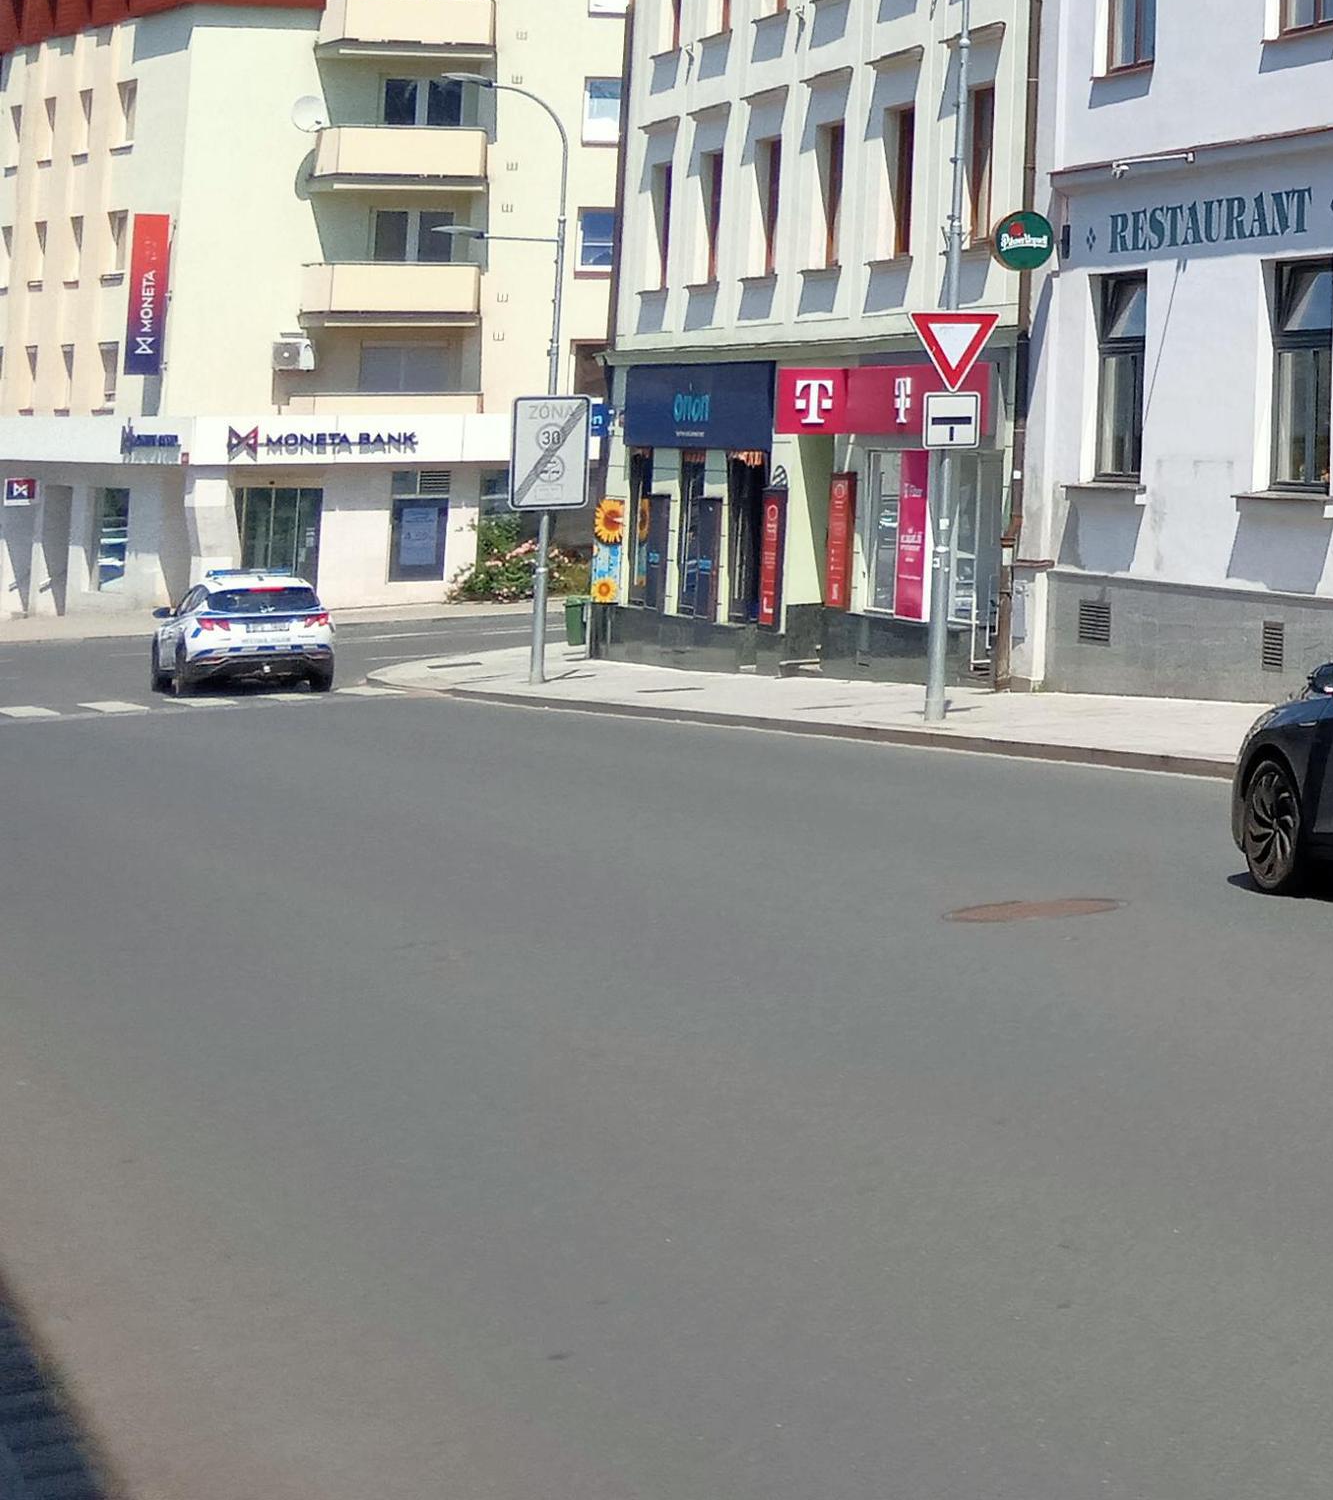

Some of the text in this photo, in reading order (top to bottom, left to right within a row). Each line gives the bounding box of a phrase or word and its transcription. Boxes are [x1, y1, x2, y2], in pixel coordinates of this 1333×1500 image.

[1107, 187, 1314, 254] RESTAURANT
[140, 269, 157, 333] MONETA
[795, 379, 834, 425] T
[266, 431, 418, 448] MONETA BANK
[541, 430, 561, 445] 30
